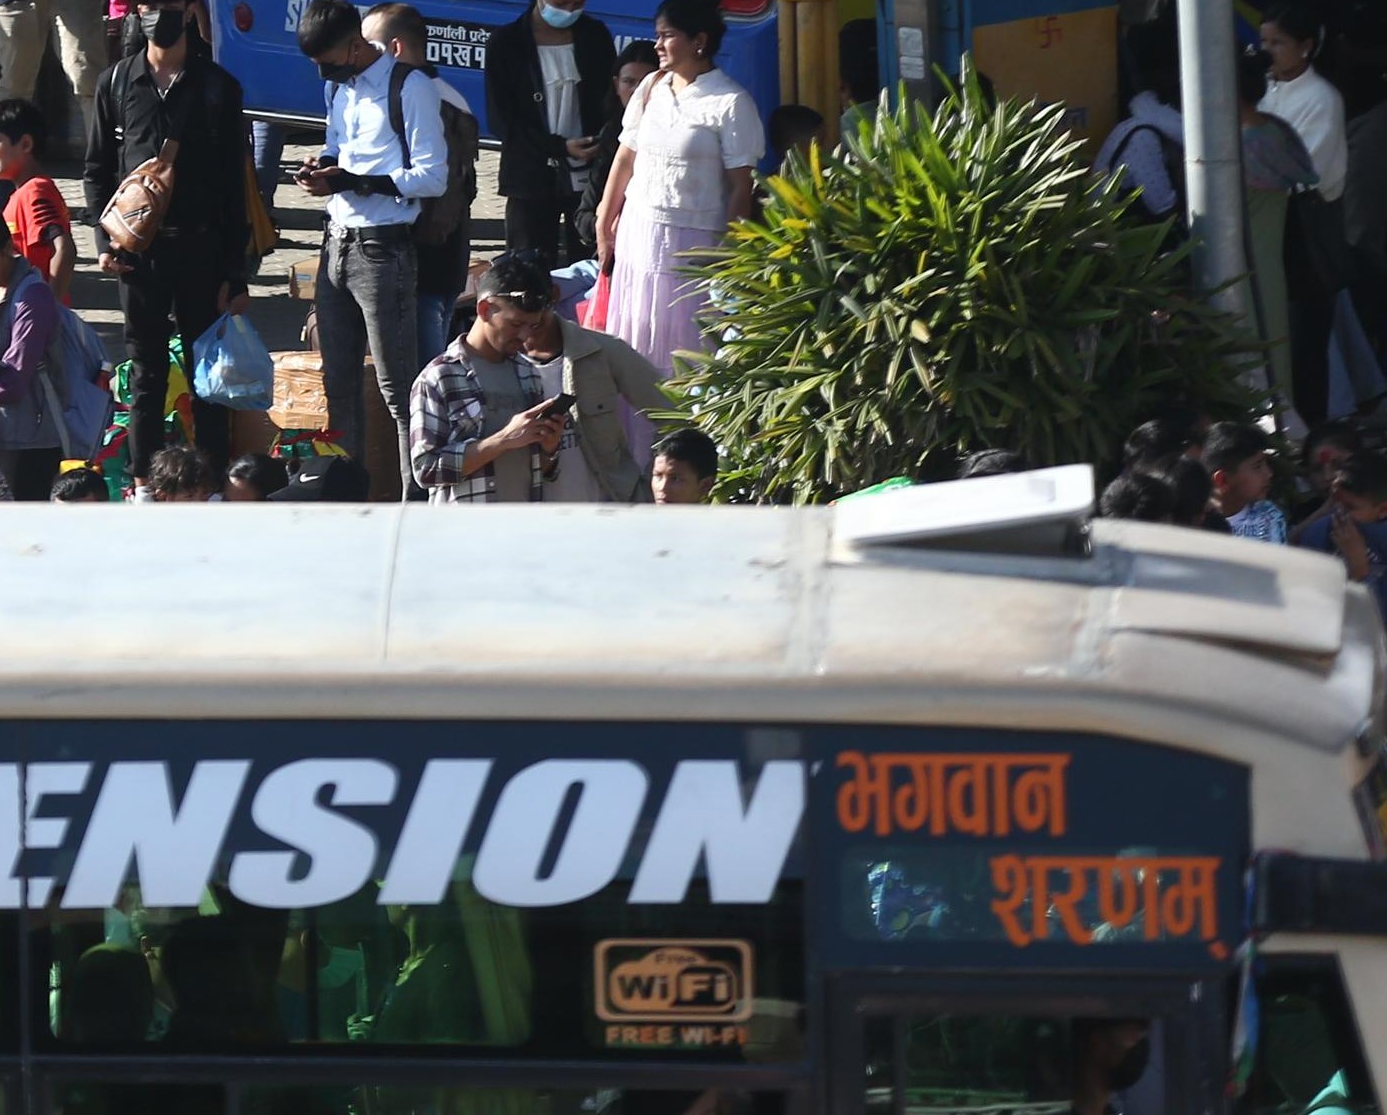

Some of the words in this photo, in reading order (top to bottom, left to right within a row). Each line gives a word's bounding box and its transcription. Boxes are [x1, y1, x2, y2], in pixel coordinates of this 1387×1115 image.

[836, 751, 1073, 838] भगवान
[990, 855, 1231, 960] शरणम्
[606, 1026, 673, 1046] FREE
[681, 1026, 748, 1046] WI-FI
